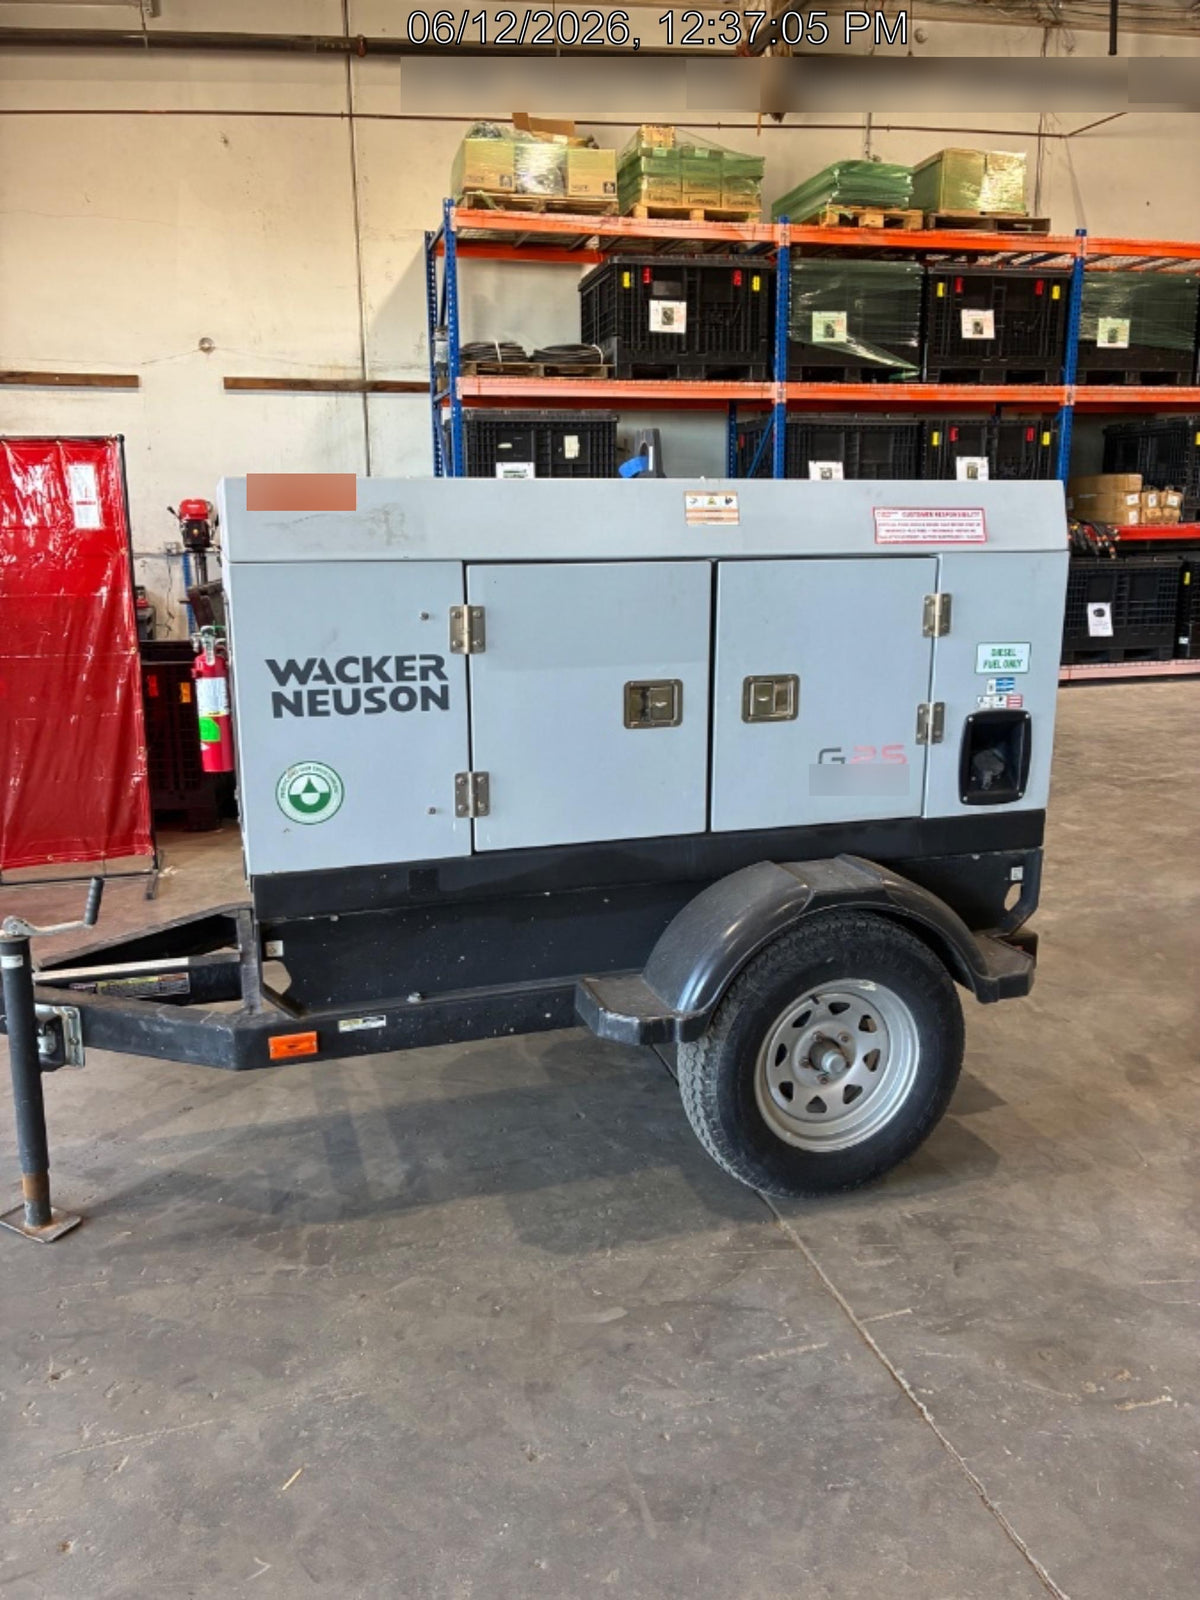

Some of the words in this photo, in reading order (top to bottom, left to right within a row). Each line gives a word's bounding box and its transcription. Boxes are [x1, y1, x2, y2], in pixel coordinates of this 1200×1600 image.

[991, 648, 1017, 657] DIESEL
[264, 654, 449, 687] WACKER
[983, 660, 1001, 669] FUEL
[1003, 659, 1023, 668] ONLY
[271, 684, 450, 718] NEUSON
